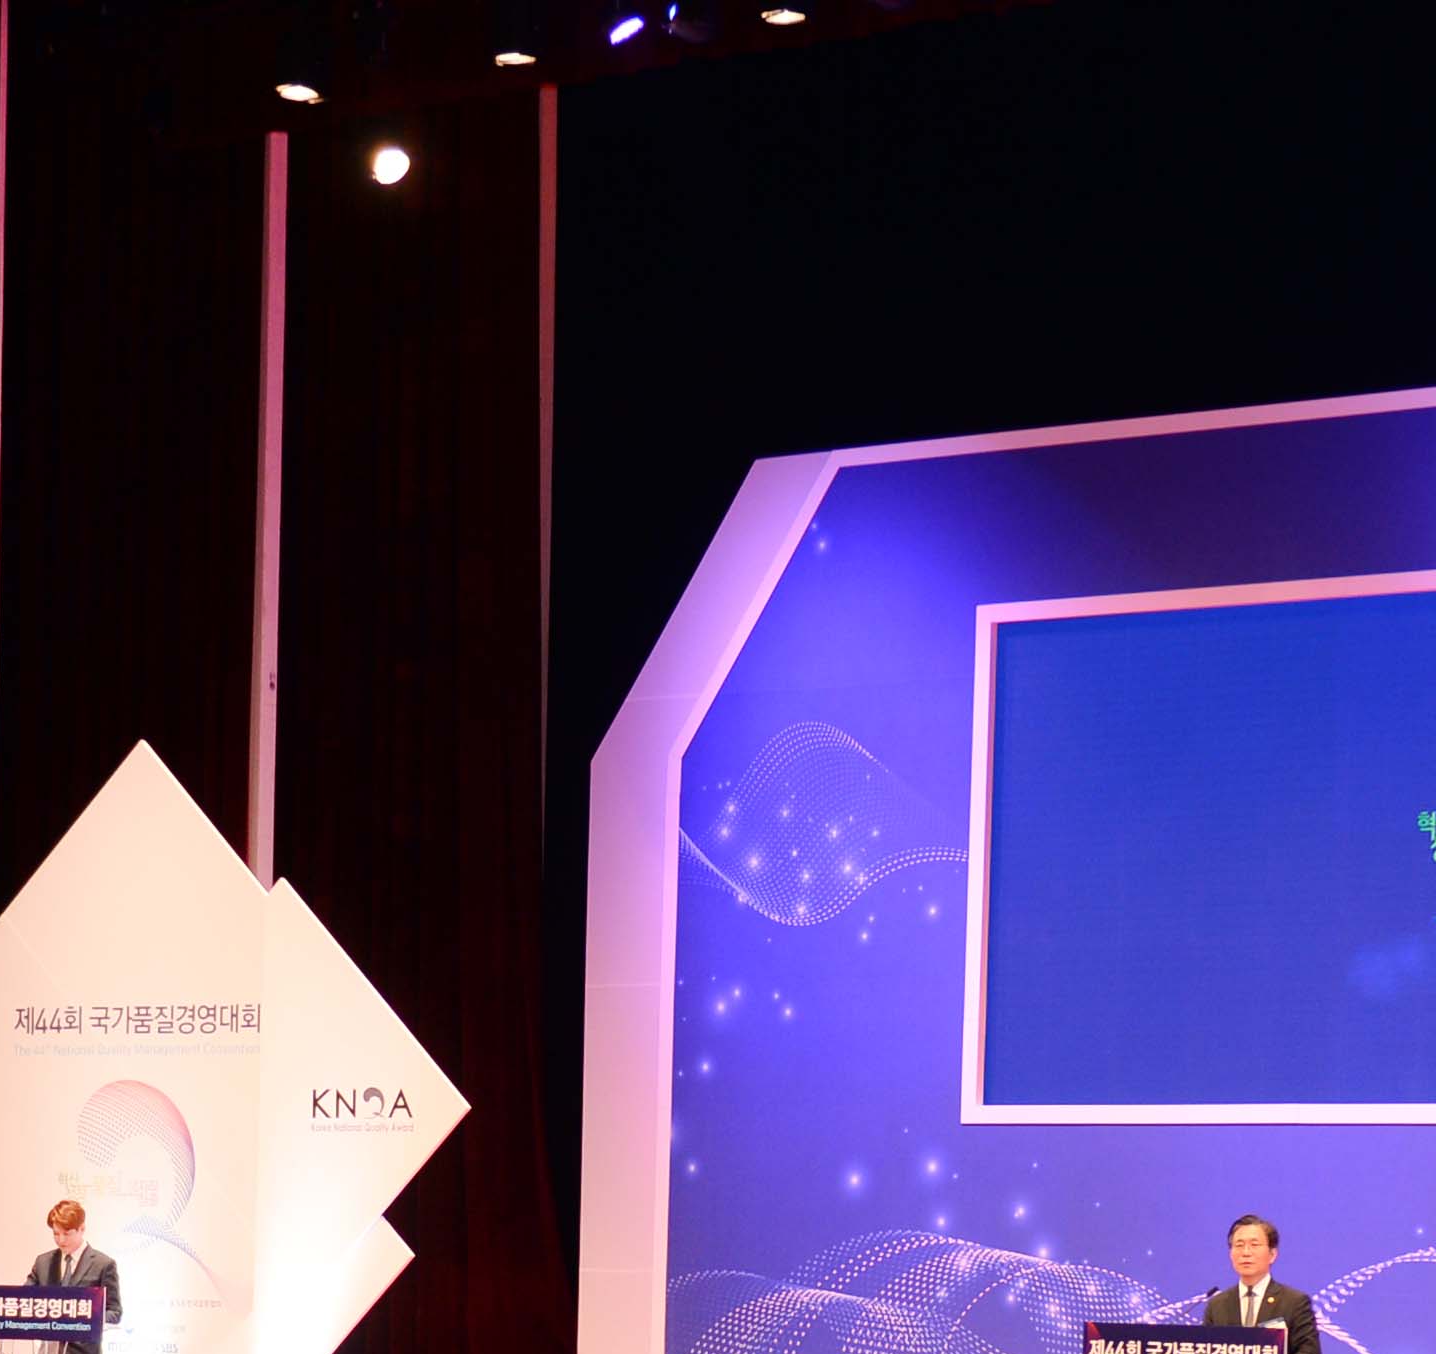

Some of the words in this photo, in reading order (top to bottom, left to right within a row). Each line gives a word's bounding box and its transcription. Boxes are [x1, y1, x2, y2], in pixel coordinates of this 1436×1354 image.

[14, 1005, 83, 1036] 제44회
[89, 1003, 261, 1035] 국가품질경영대회
[312, 1087, 413, 1119] KNQA
